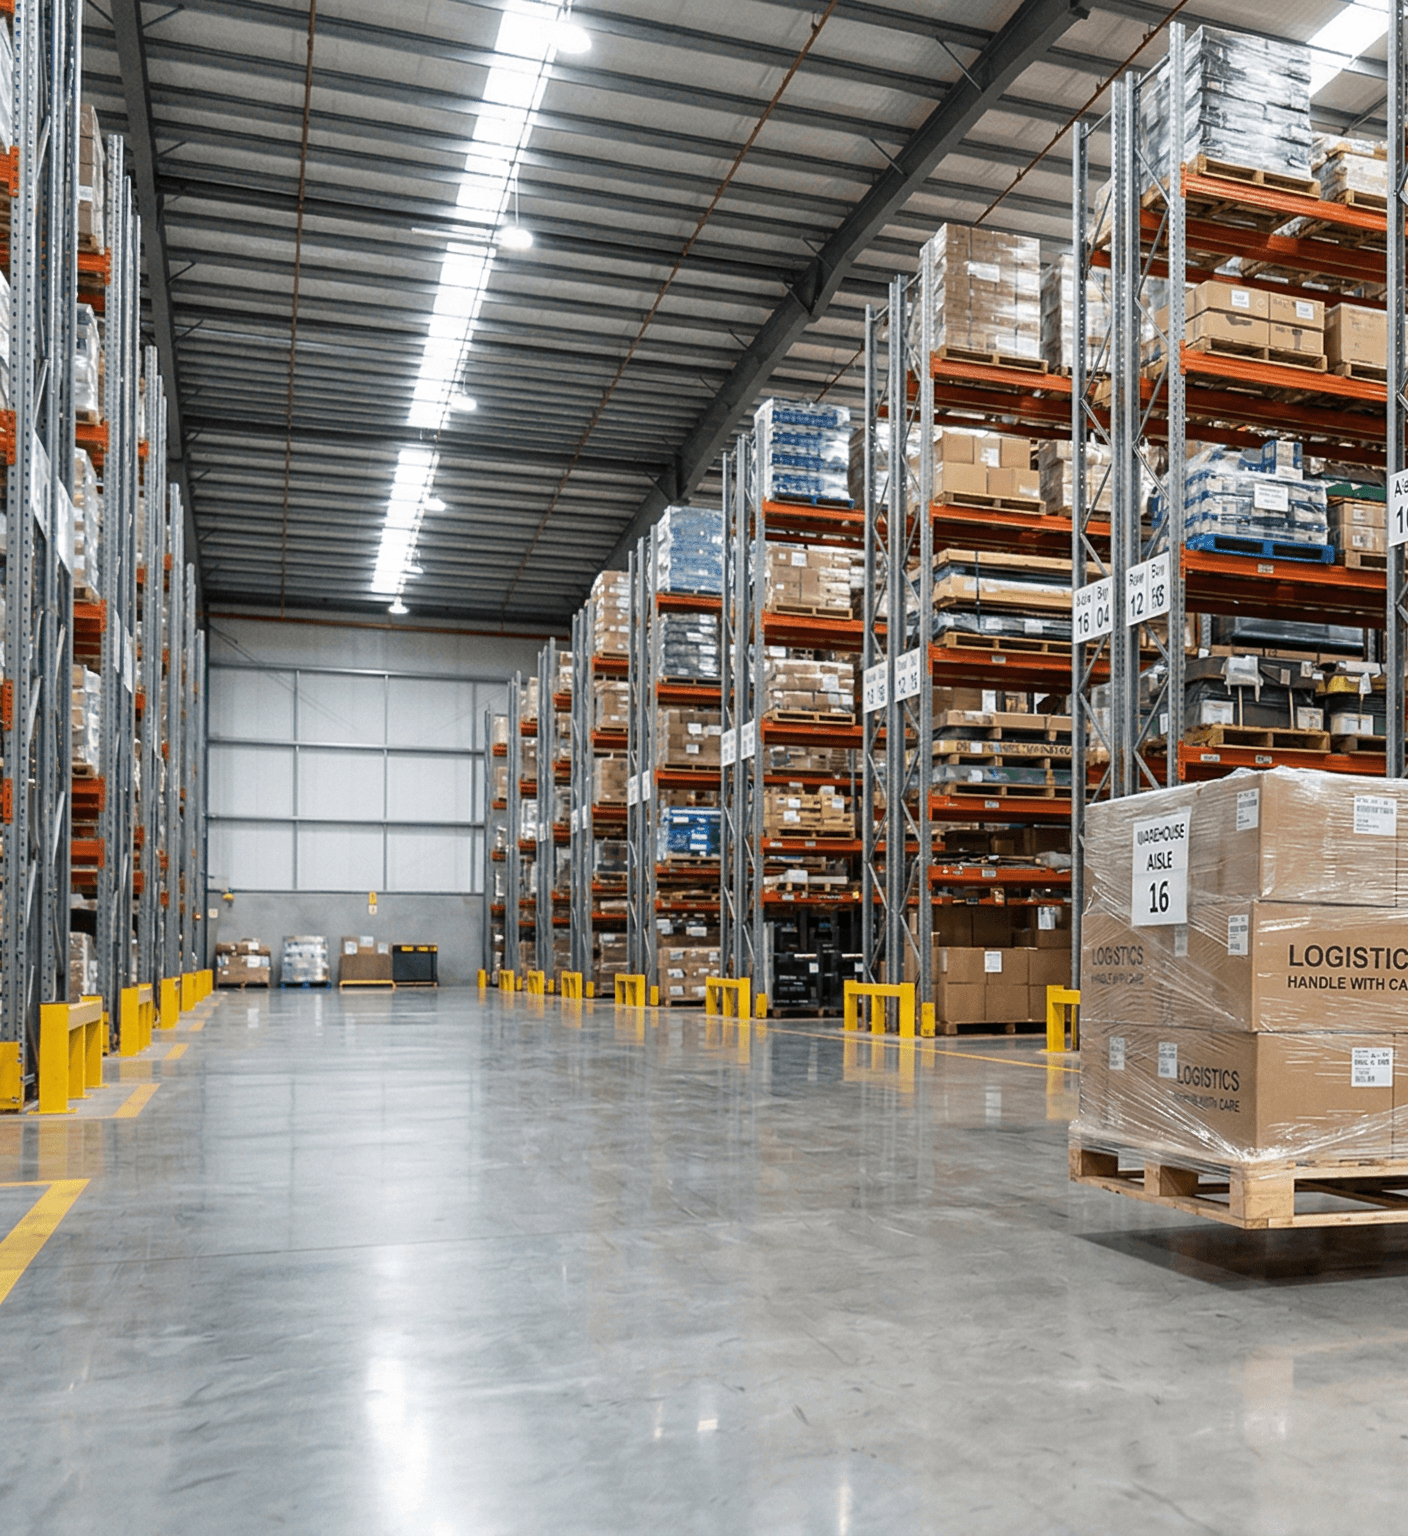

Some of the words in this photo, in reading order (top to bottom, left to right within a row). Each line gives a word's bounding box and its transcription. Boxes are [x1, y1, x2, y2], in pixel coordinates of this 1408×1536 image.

[1130, 591, 1143, 617] 12
[1078, 611, 1089, 634] 16
[1096, 603, 1109, 628] 04
[1146, 850, 1173, 871] AISLE
[1149, 880, 1169, 913] 16
[1287, 975, 1347, 990] HANDLE
[1350, 977, 1385, 991] WITH
[1177, 1063, 1240, 1092] LOGISTICS
